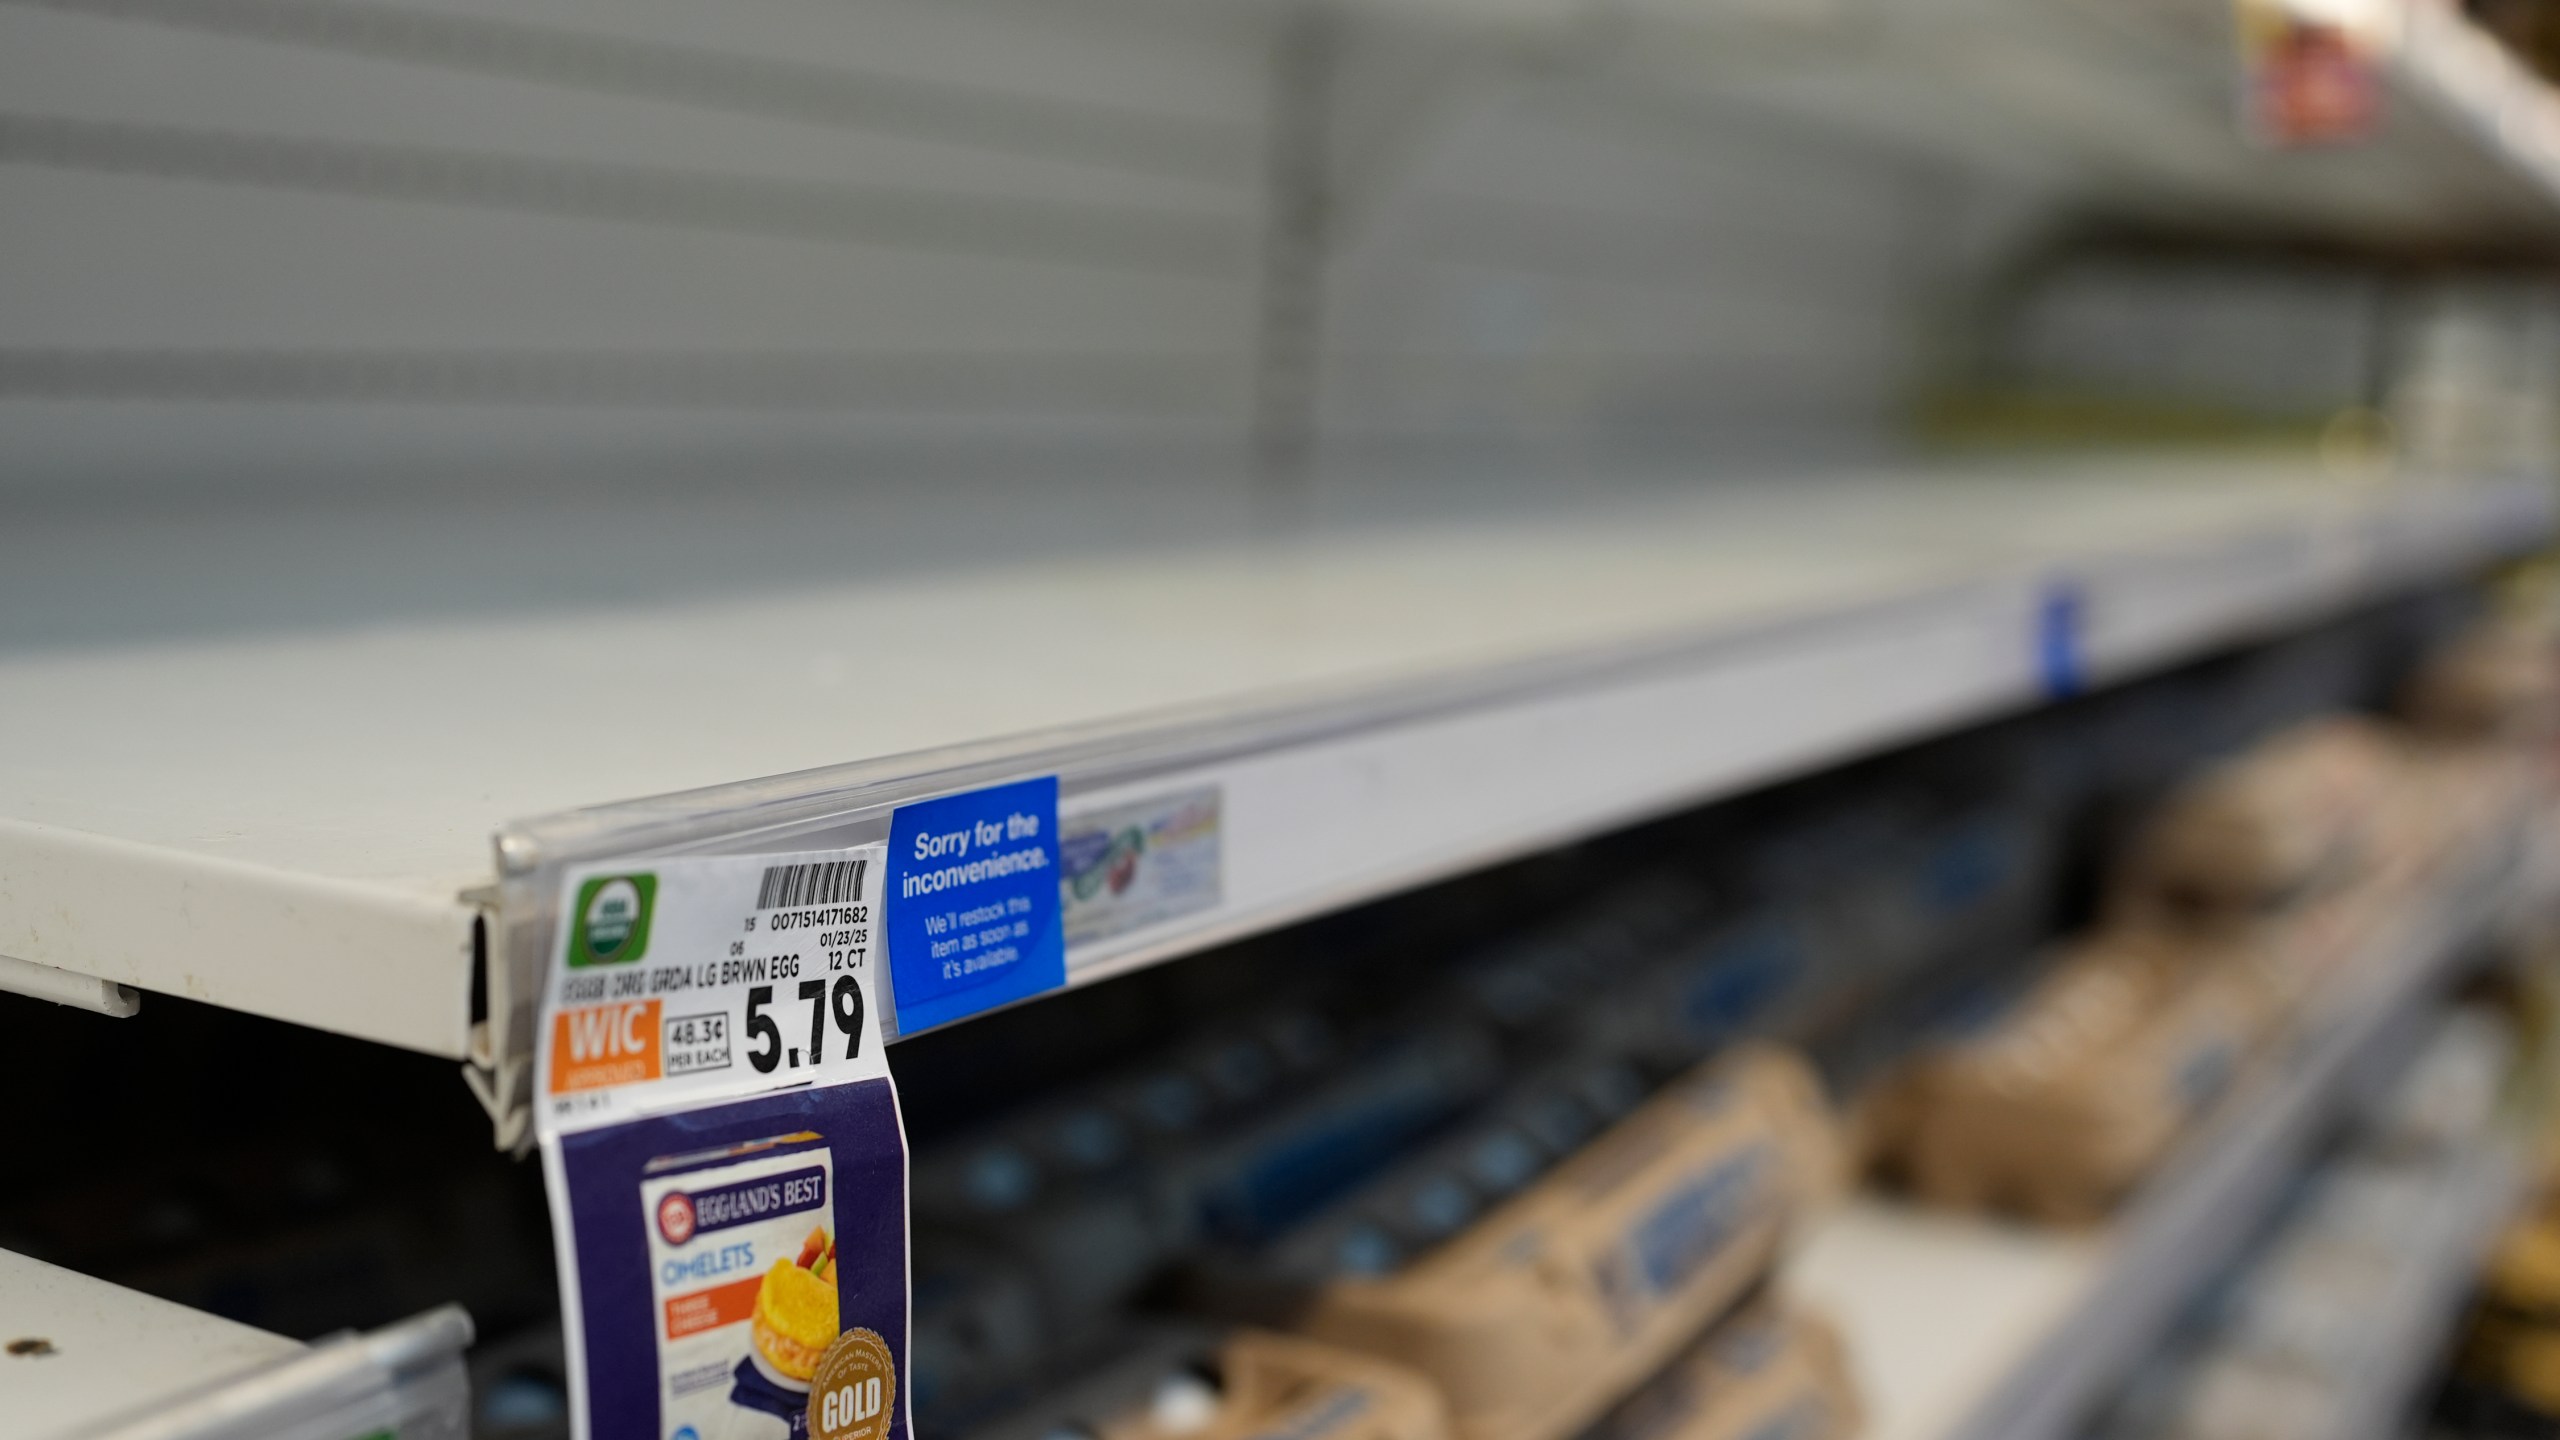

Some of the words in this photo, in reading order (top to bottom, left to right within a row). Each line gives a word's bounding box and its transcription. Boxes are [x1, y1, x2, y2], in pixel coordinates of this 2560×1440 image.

[914, 832, 970, 860] Sorry
[975, 820, 1004, 847] for
[1007, 812, 1039, 841] the
[903, 846, 1050, 899] inconvenience.
[771, 906, 868, 931] 0071514171682
[820, 929, 867, 948] 01/23/25
[828, 951, 843, 971] 12
[846, 948, 866, 969] CT
[931, 938, 960, 959] item
[697, 962, 717, 988] LG
[721, 957, 767, 985] BRWN
[771, 953, 800, 979] EGG
[569, 1004, 648, 1062] WIC
[672, 1020, 722, 1045] 48.3¢
[746, 975, 865, 1073] 5.79
[696, 1184, 780, 1226] EGGLAND'S
[784, 1175, 822, 1206] BEST
[822, 1377, 881, 1433] GOLD
